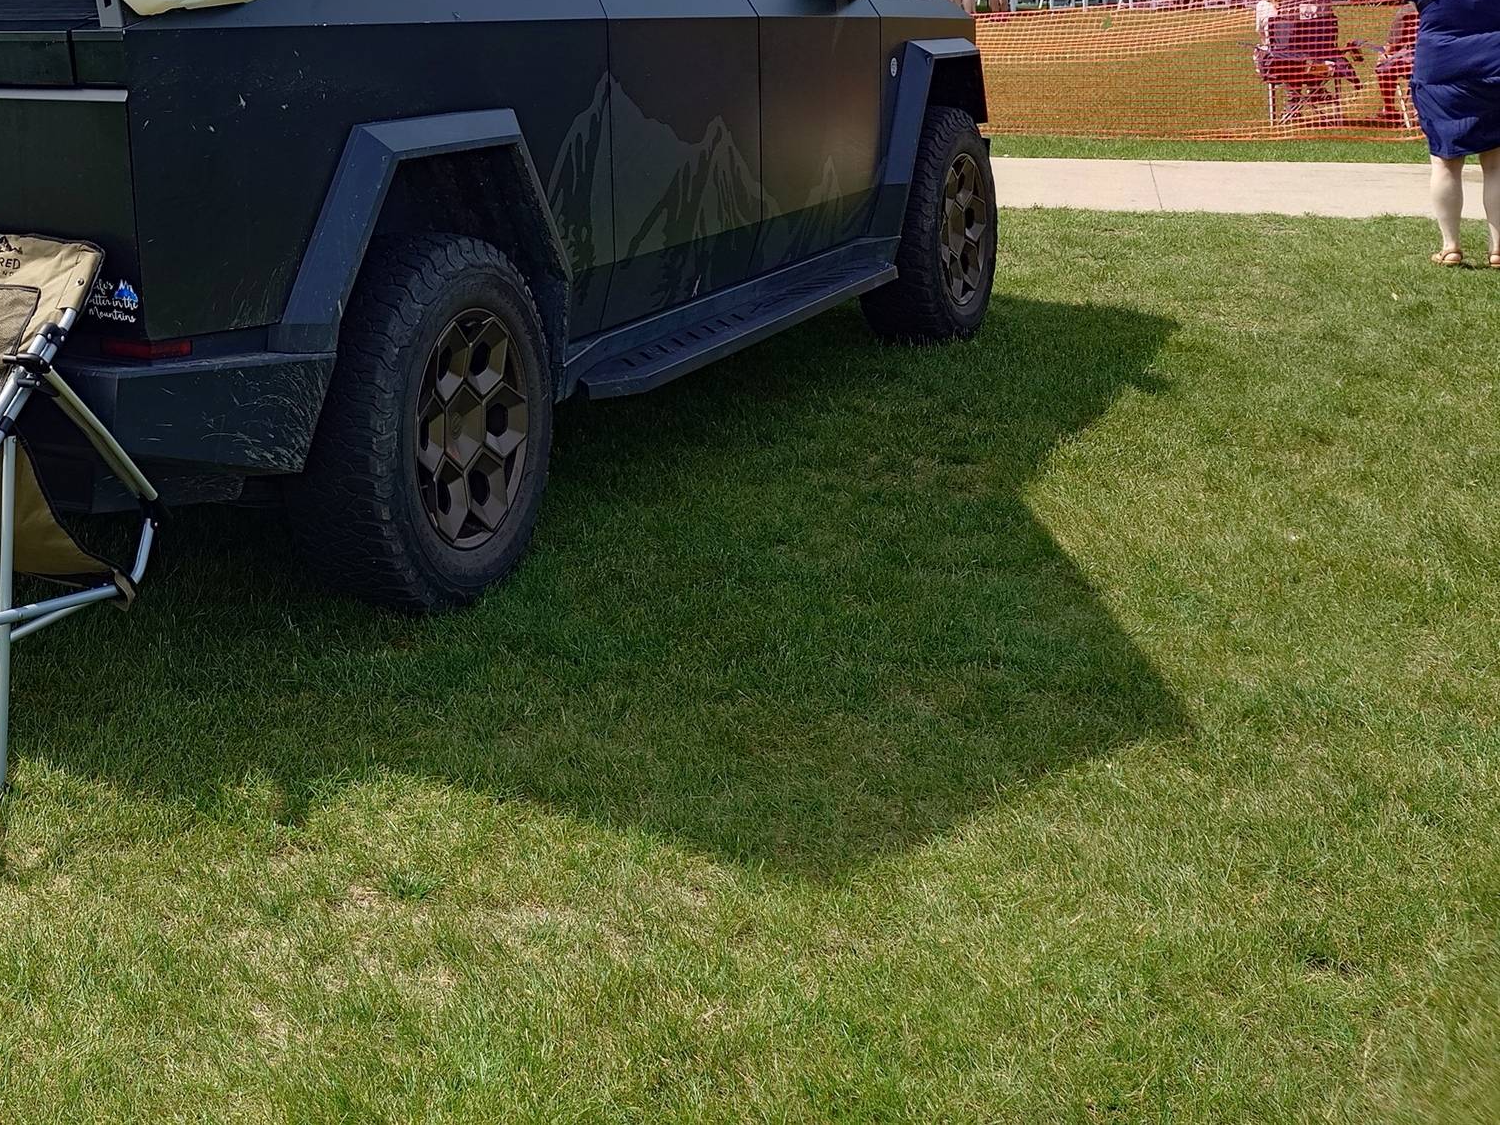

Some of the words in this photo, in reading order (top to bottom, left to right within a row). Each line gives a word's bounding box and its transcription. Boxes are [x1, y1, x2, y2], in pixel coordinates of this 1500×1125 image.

[93, 278, 114, 295] ife's
[89, 293, 111, 306] etter
[122, 295, 138, 310] the
[89, 306, 136, 323] Mountains
